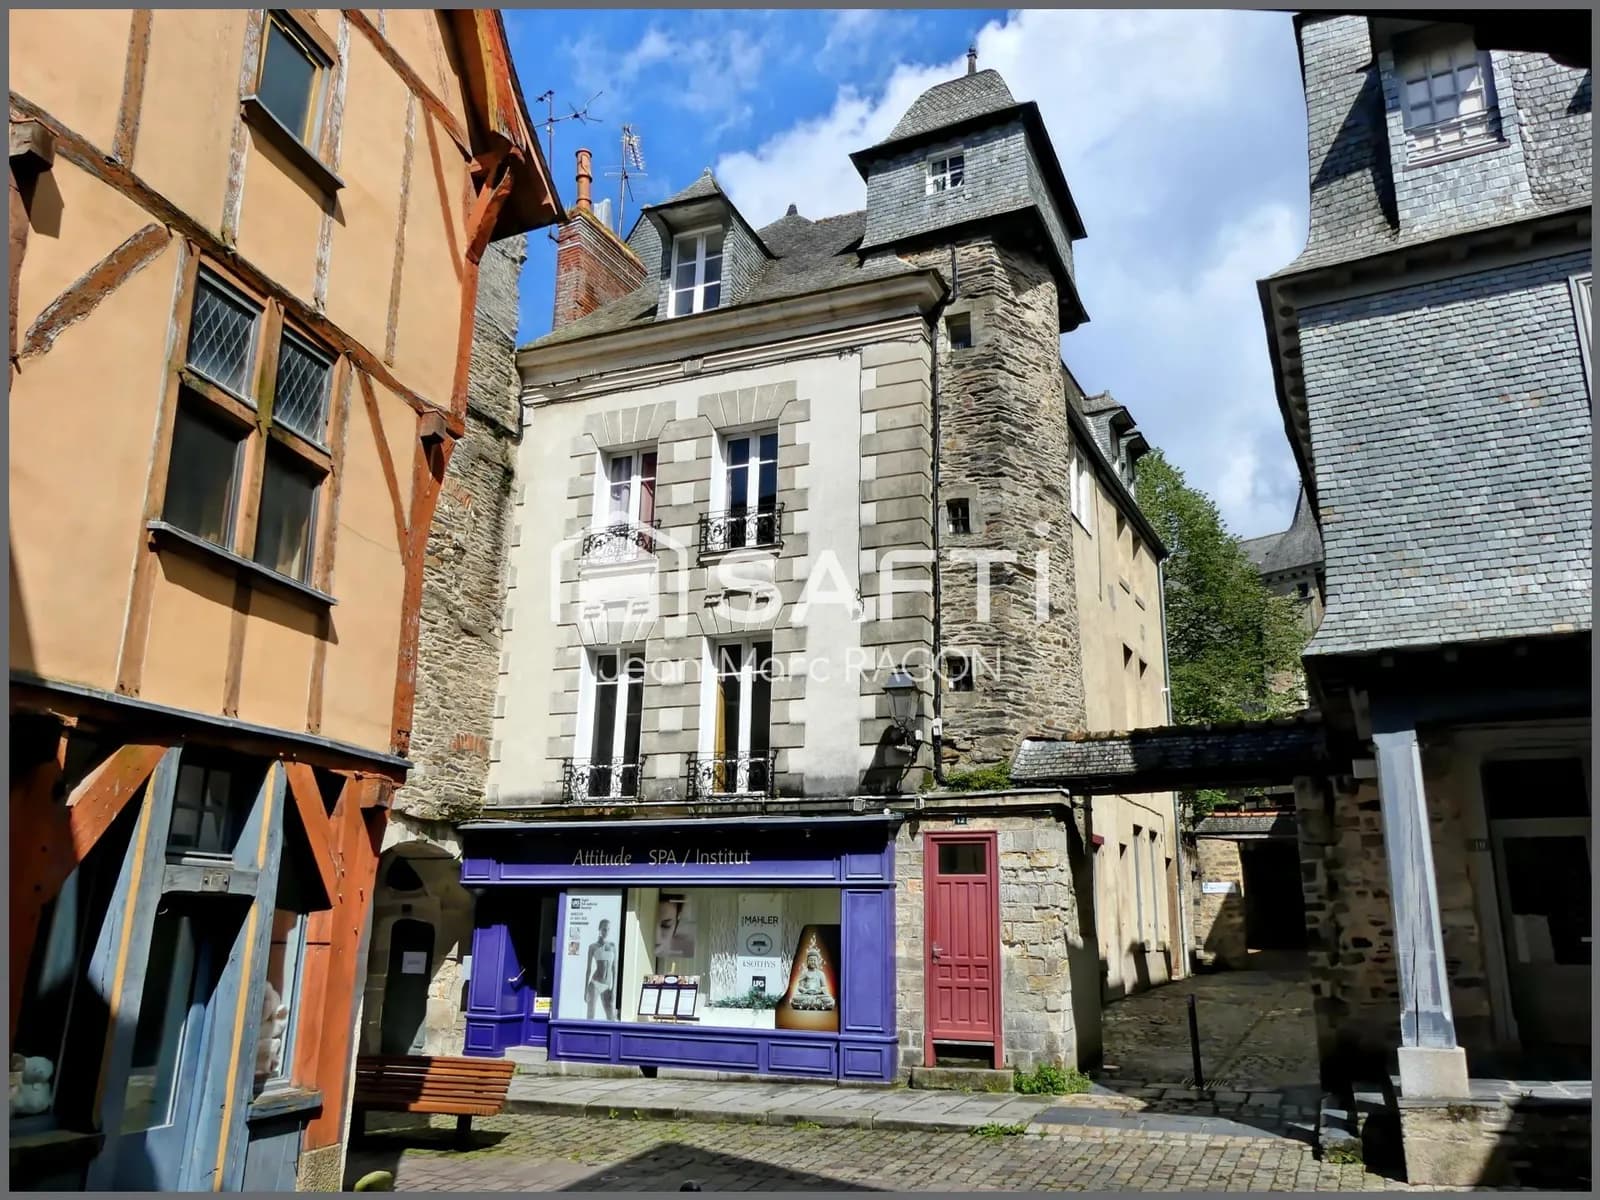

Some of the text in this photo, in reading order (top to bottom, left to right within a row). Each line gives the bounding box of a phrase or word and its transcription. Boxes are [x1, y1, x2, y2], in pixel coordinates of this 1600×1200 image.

[572, 846, 751, 867] Attitude SPA / Institut
[744, 915, 779, 924] MAHLER
